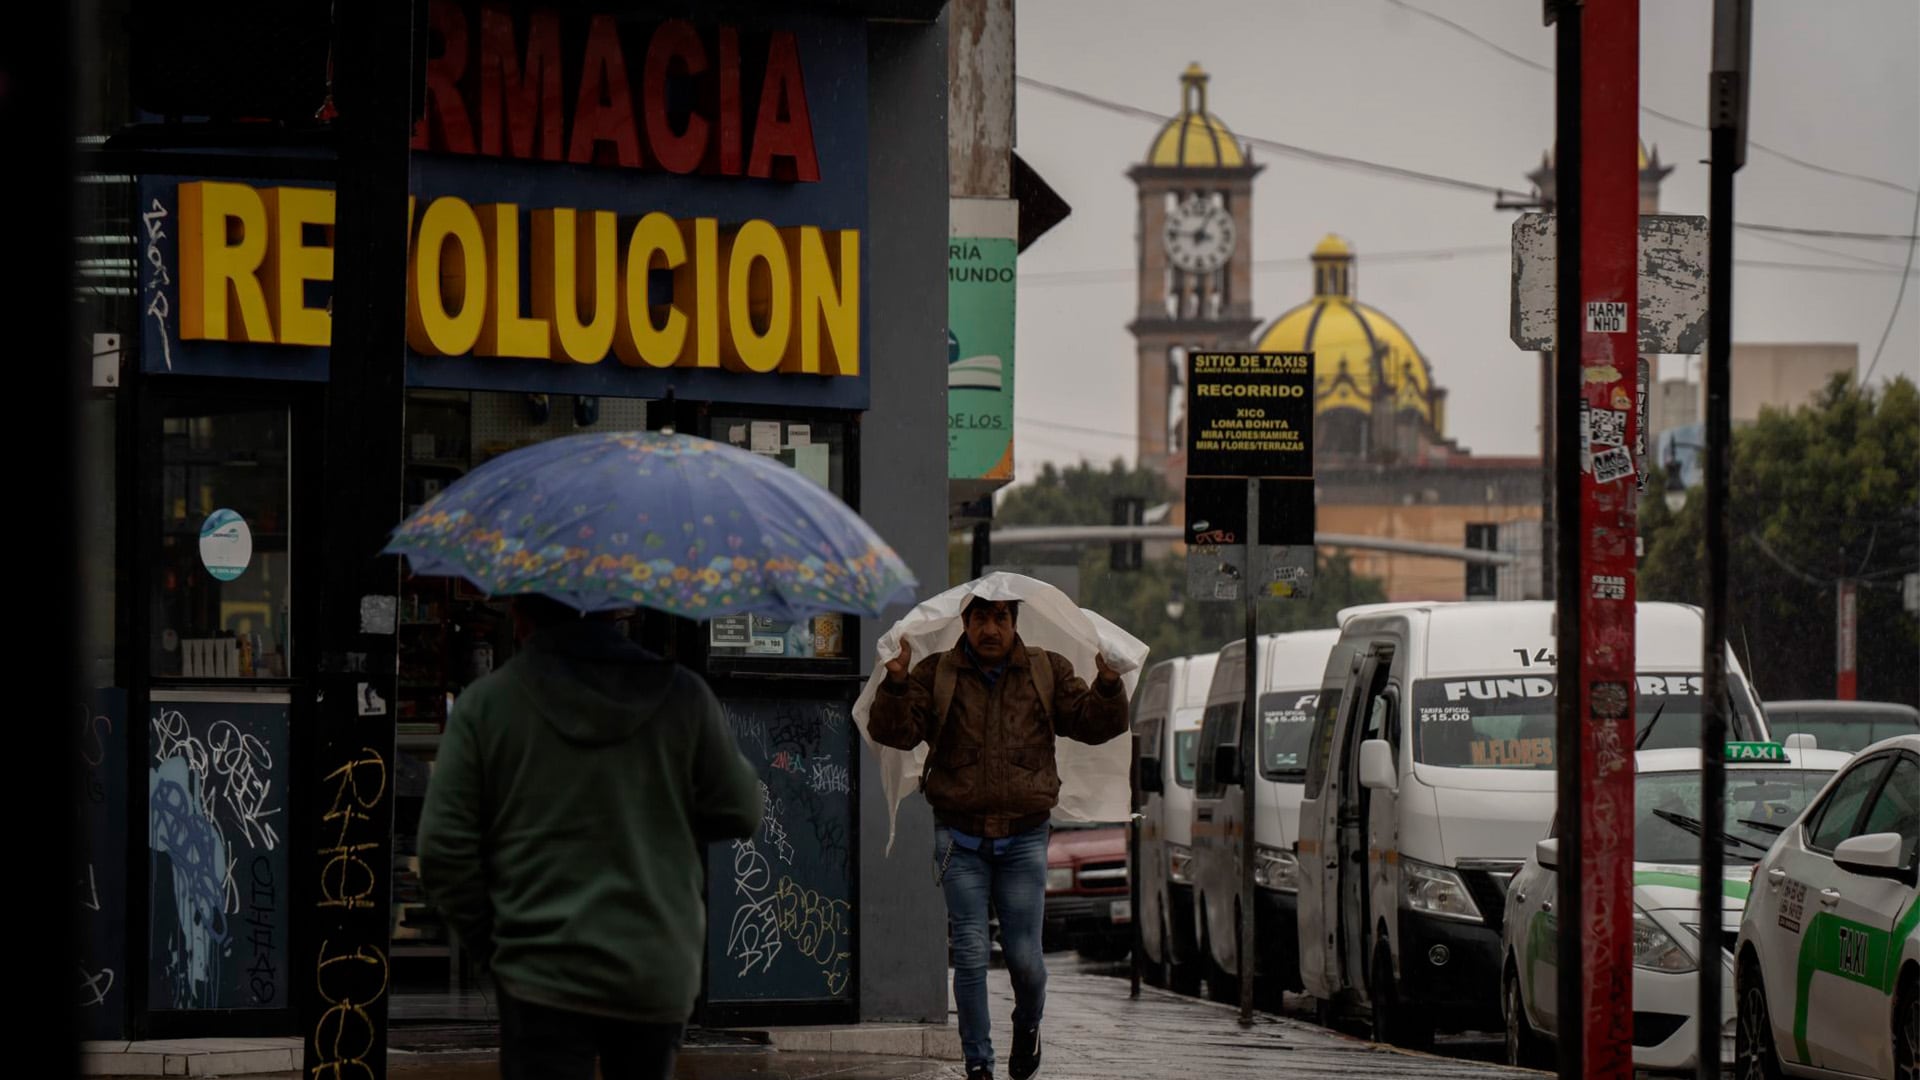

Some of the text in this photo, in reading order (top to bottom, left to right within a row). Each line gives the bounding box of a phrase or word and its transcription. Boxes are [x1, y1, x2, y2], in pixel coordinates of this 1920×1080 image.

[413, 0, 820, 182] RMACIA
[949, 242, 982, 260] RÍA
[179, 181, 860, 376] REOLUCION
[1589, 303, 1625, 318] HARM
[1594, 317, 1620, 332] NHD
[1195, 355, 1308, 368] SITIO DE TAXIS
[1197, 383, 1304, 398] RECORRIDO
[1236, 408, 1265, 418] XICO
[970, 414, 1002, 429] LOS
[1211, 419, 1289, 429] LOMA BONITA
[1201, 430, 1224, 440] MIRA
[1196, 441, 1219, 451] MIRA
[1421, 713, 1470, 722] $15.00
[1727, 744, 1777, 760] TAXI
[1839, 925, 1869, 977] TAXI
